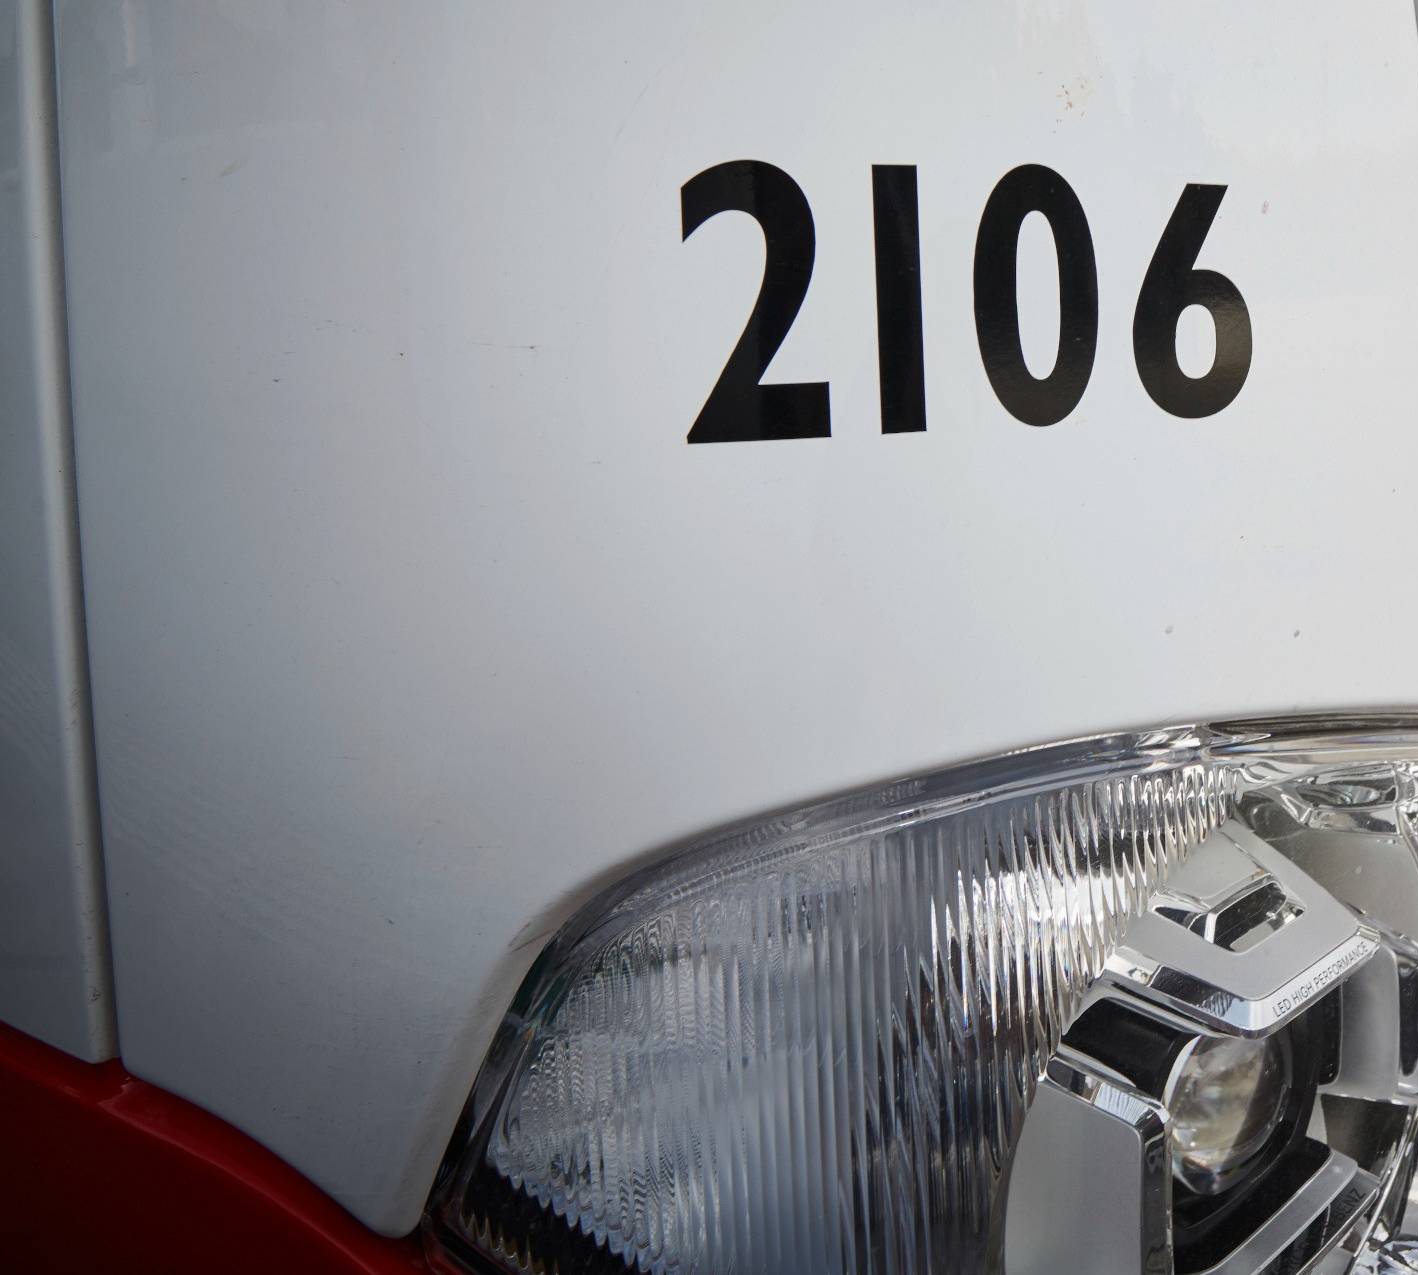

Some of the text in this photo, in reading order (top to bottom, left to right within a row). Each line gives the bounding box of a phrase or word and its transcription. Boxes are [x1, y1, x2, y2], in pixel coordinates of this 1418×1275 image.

[681, 159, 1252, 444] 2106
[1272, 941, 1368, 1018] LED HIGH PERFORMANCE
